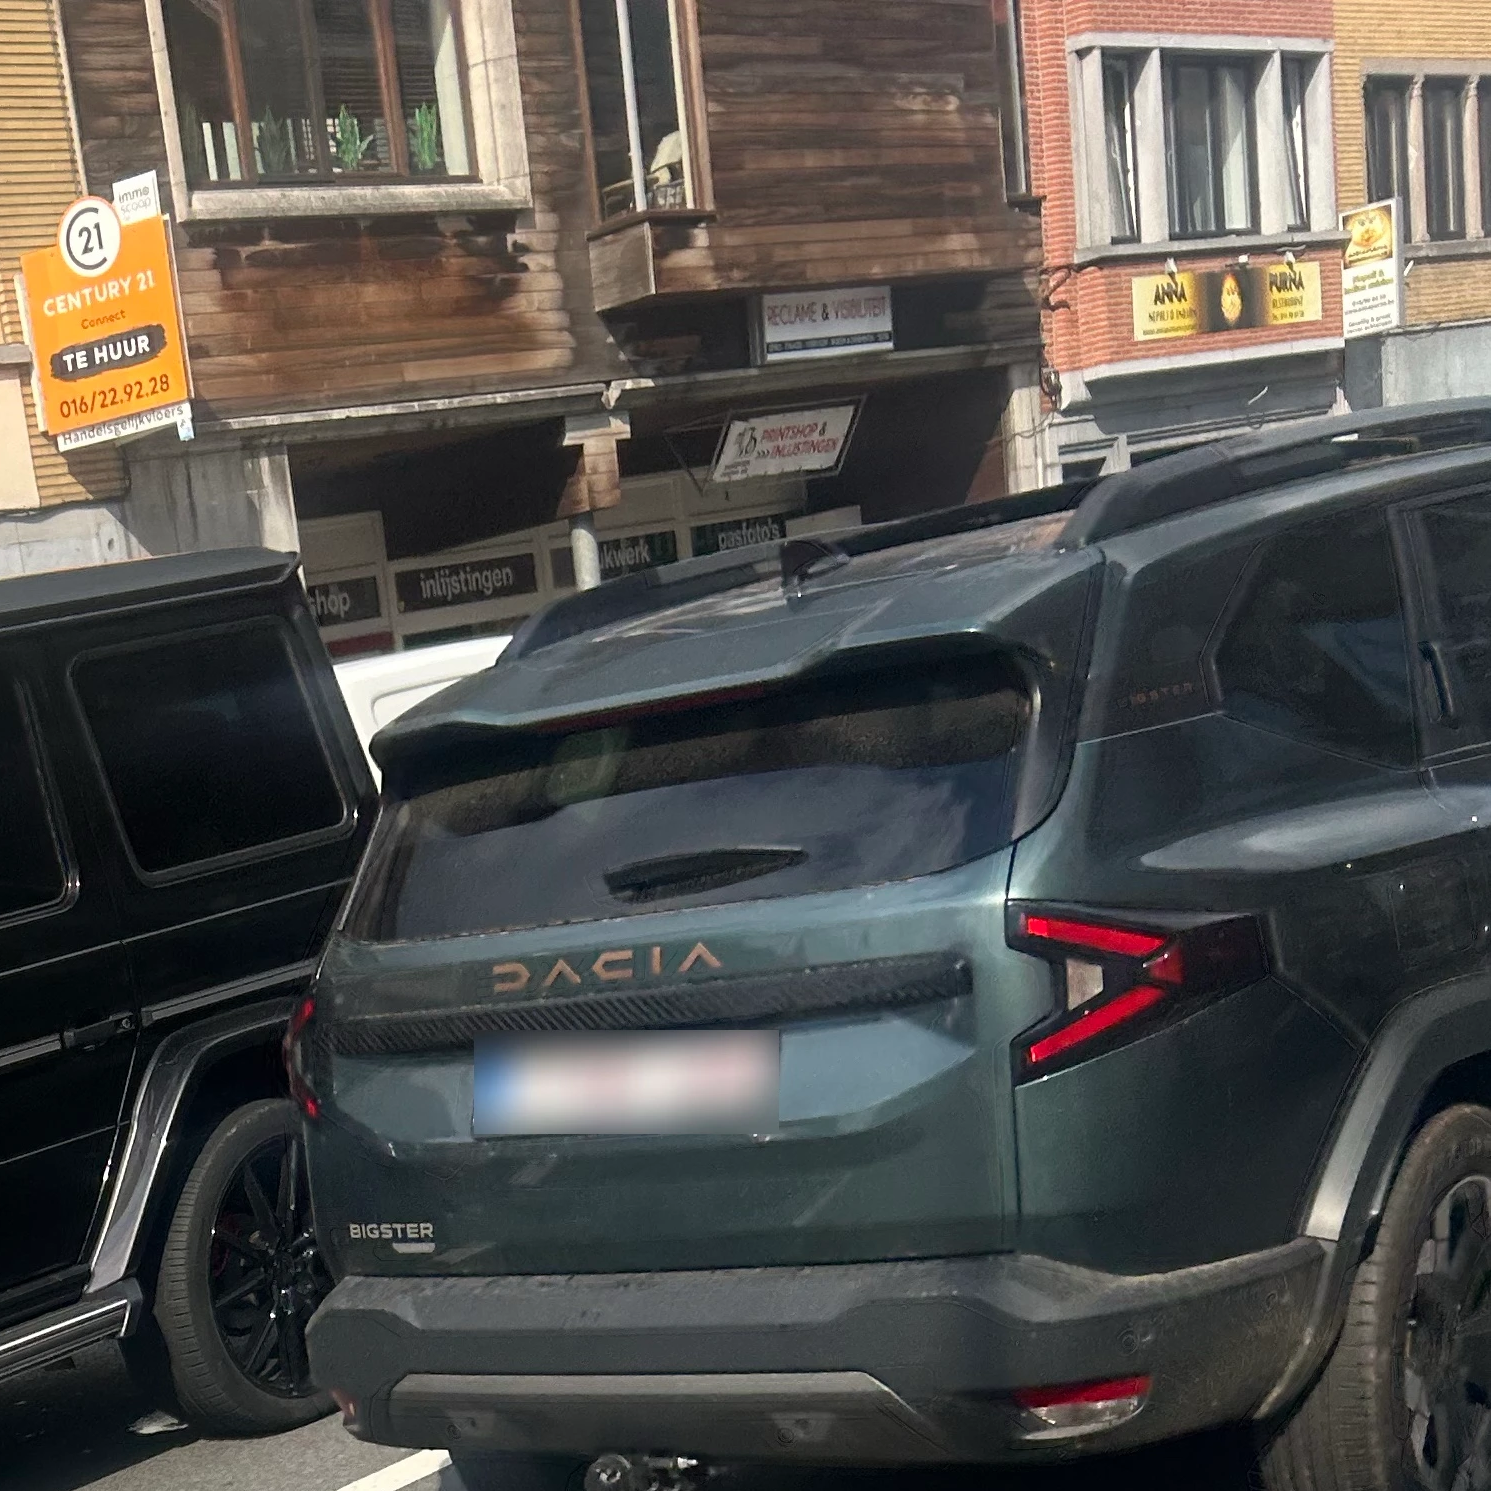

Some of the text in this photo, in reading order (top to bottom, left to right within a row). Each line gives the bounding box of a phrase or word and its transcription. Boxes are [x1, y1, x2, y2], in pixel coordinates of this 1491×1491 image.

[78, 221, 104, 255] 21
[42, 269, 155, 317] CENTURY 21
[1153, 282, 1188, 306] ANNA
[80, 309, 127, 330] Connect
[767, 302, 818, 326] RECLAME
[821, 303, 830, 321] &
[62, 335, 151, 372] TE HUUR
[60, 373, 170, 419] 016/22.92.28
[419, 566, 514, 601] inlijstingen
[492, 941, 723, 994] DACIA
[349, 1222, 434, 1240] BIGSTER
